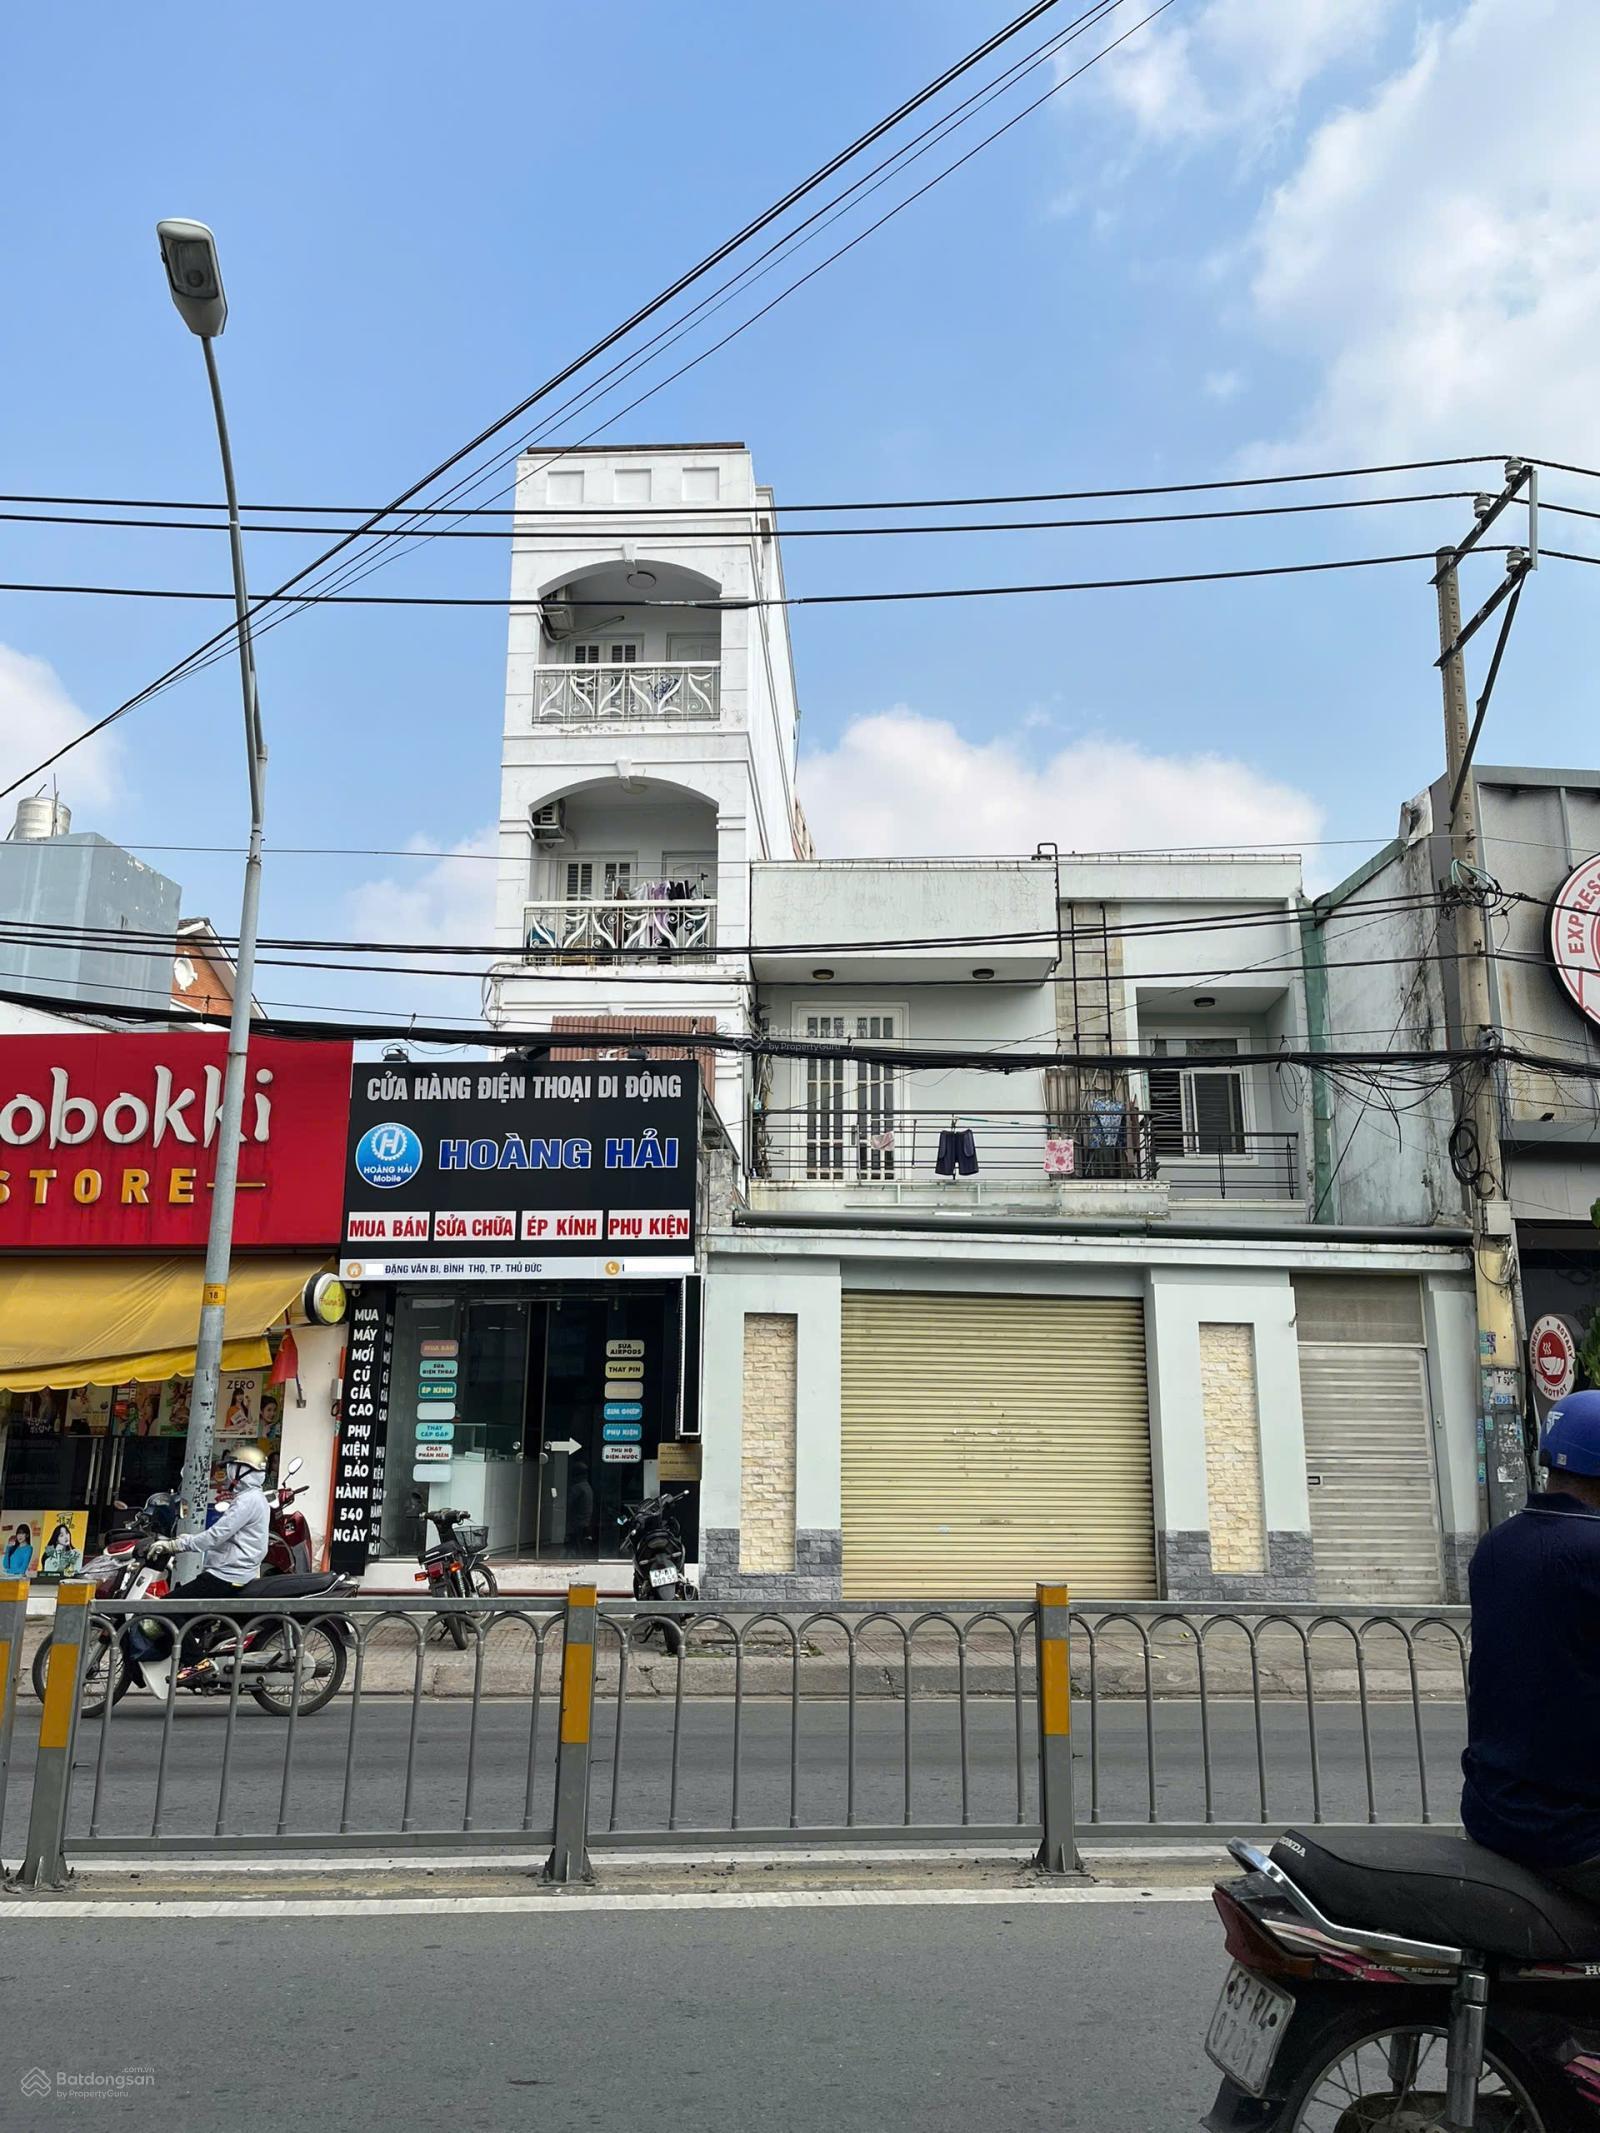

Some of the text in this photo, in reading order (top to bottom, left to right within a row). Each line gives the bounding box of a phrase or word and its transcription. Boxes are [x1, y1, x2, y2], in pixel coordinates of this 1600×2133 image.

[1568, 871, 1600, 953] EXPRES
[367, 1070, 681, 1103] CỬA HÀNG ĐIỆN THOẠI DI ĐỘNG
[438, 1128, 679, 1170] HOÀNG HẢI
[363, 1163, 413, 1174] HOÀNG HẢI
[373, 1174, 402, 1183] Mobile
[349, 1216, 428, 1237] MUA BÁN
[436, 1213, 513, 1237] SỬA CHỮA
[527, 1214, 597, 1236] ÉP KÍNH
[609, 1214, 688, 1238] PHỤ KIỆN
[385, 1264, 409, 1275] ĐẶNG
[411, 1263, 428, 1274] VĂN
[443, 1262, 464, 1273] BÌNH
[490, 1264, 503, 1273] TP.
[506, 1261, 523, 1273] THỦ
[524, 1262, 542, 1273] ĐỨC
[354, 1308, 379, 1321] MUA
[353, 1325, 378, 1341] MÁY
[1556, 1322, 1576, 1360] ROTARY
[351, 1343, 375, 1362] MỚI
[1531, 1326, 1541, 1365] EXPRESS
[353, 1365, 371, 1382] CŨ
[227, 1380, 255, 1390] ZERO
[350, 1384, 372, 1400] GIÁ
[1543, 1383, 1568, 1397] HOTPOT
[348, 1403, 374, 1417] CAO
[347, 1424, 371, 1440] PHỤ
[341, 1441, 370, 1460] KIỆN
[344, 1460, 369, 1477] BẢO
[335, 1483, 368, 1499] HÀNH
[340, 1507, 363, 1521] 540
[333, 1525, 367, 1542] NGÀY
[1279, 1835, 1306, 1858] HONDA
